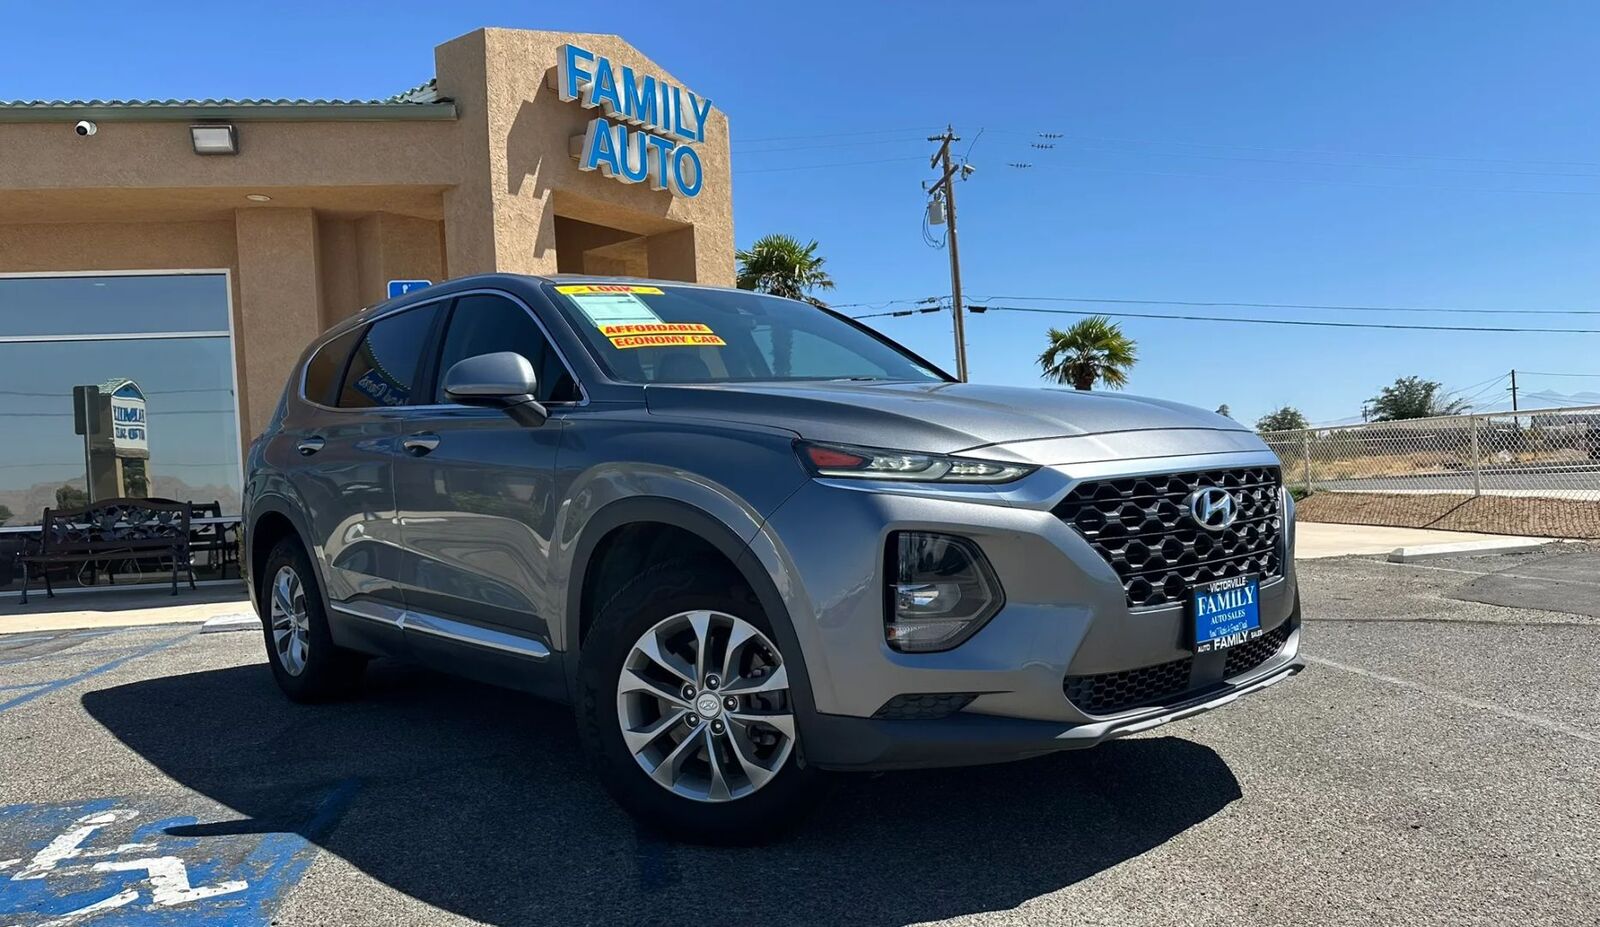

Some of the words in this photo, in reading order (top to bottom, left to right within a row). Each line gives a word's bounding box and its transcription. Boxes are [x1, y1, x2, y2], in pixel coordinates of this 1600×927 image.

[565, 43, 713, 143] FAMILY
[586, 117, 704, 198] AUTO
[587, 285, 635, 293] LOOK
[605, 323, 705, 334] AFFORDABLE
[614, 335, 686, 347] ECONOMY
[691, 335, 720, 344] CAR
[1209, 576, 1247, 593] VICTORVILLE
[1198, 585, 1255, 616] FAMILY
[1211, 614, 1227, 625] AUTO
[1227, 609, 1246, 621] SALES
[1214, 630, 1248, 651] FAMILY
